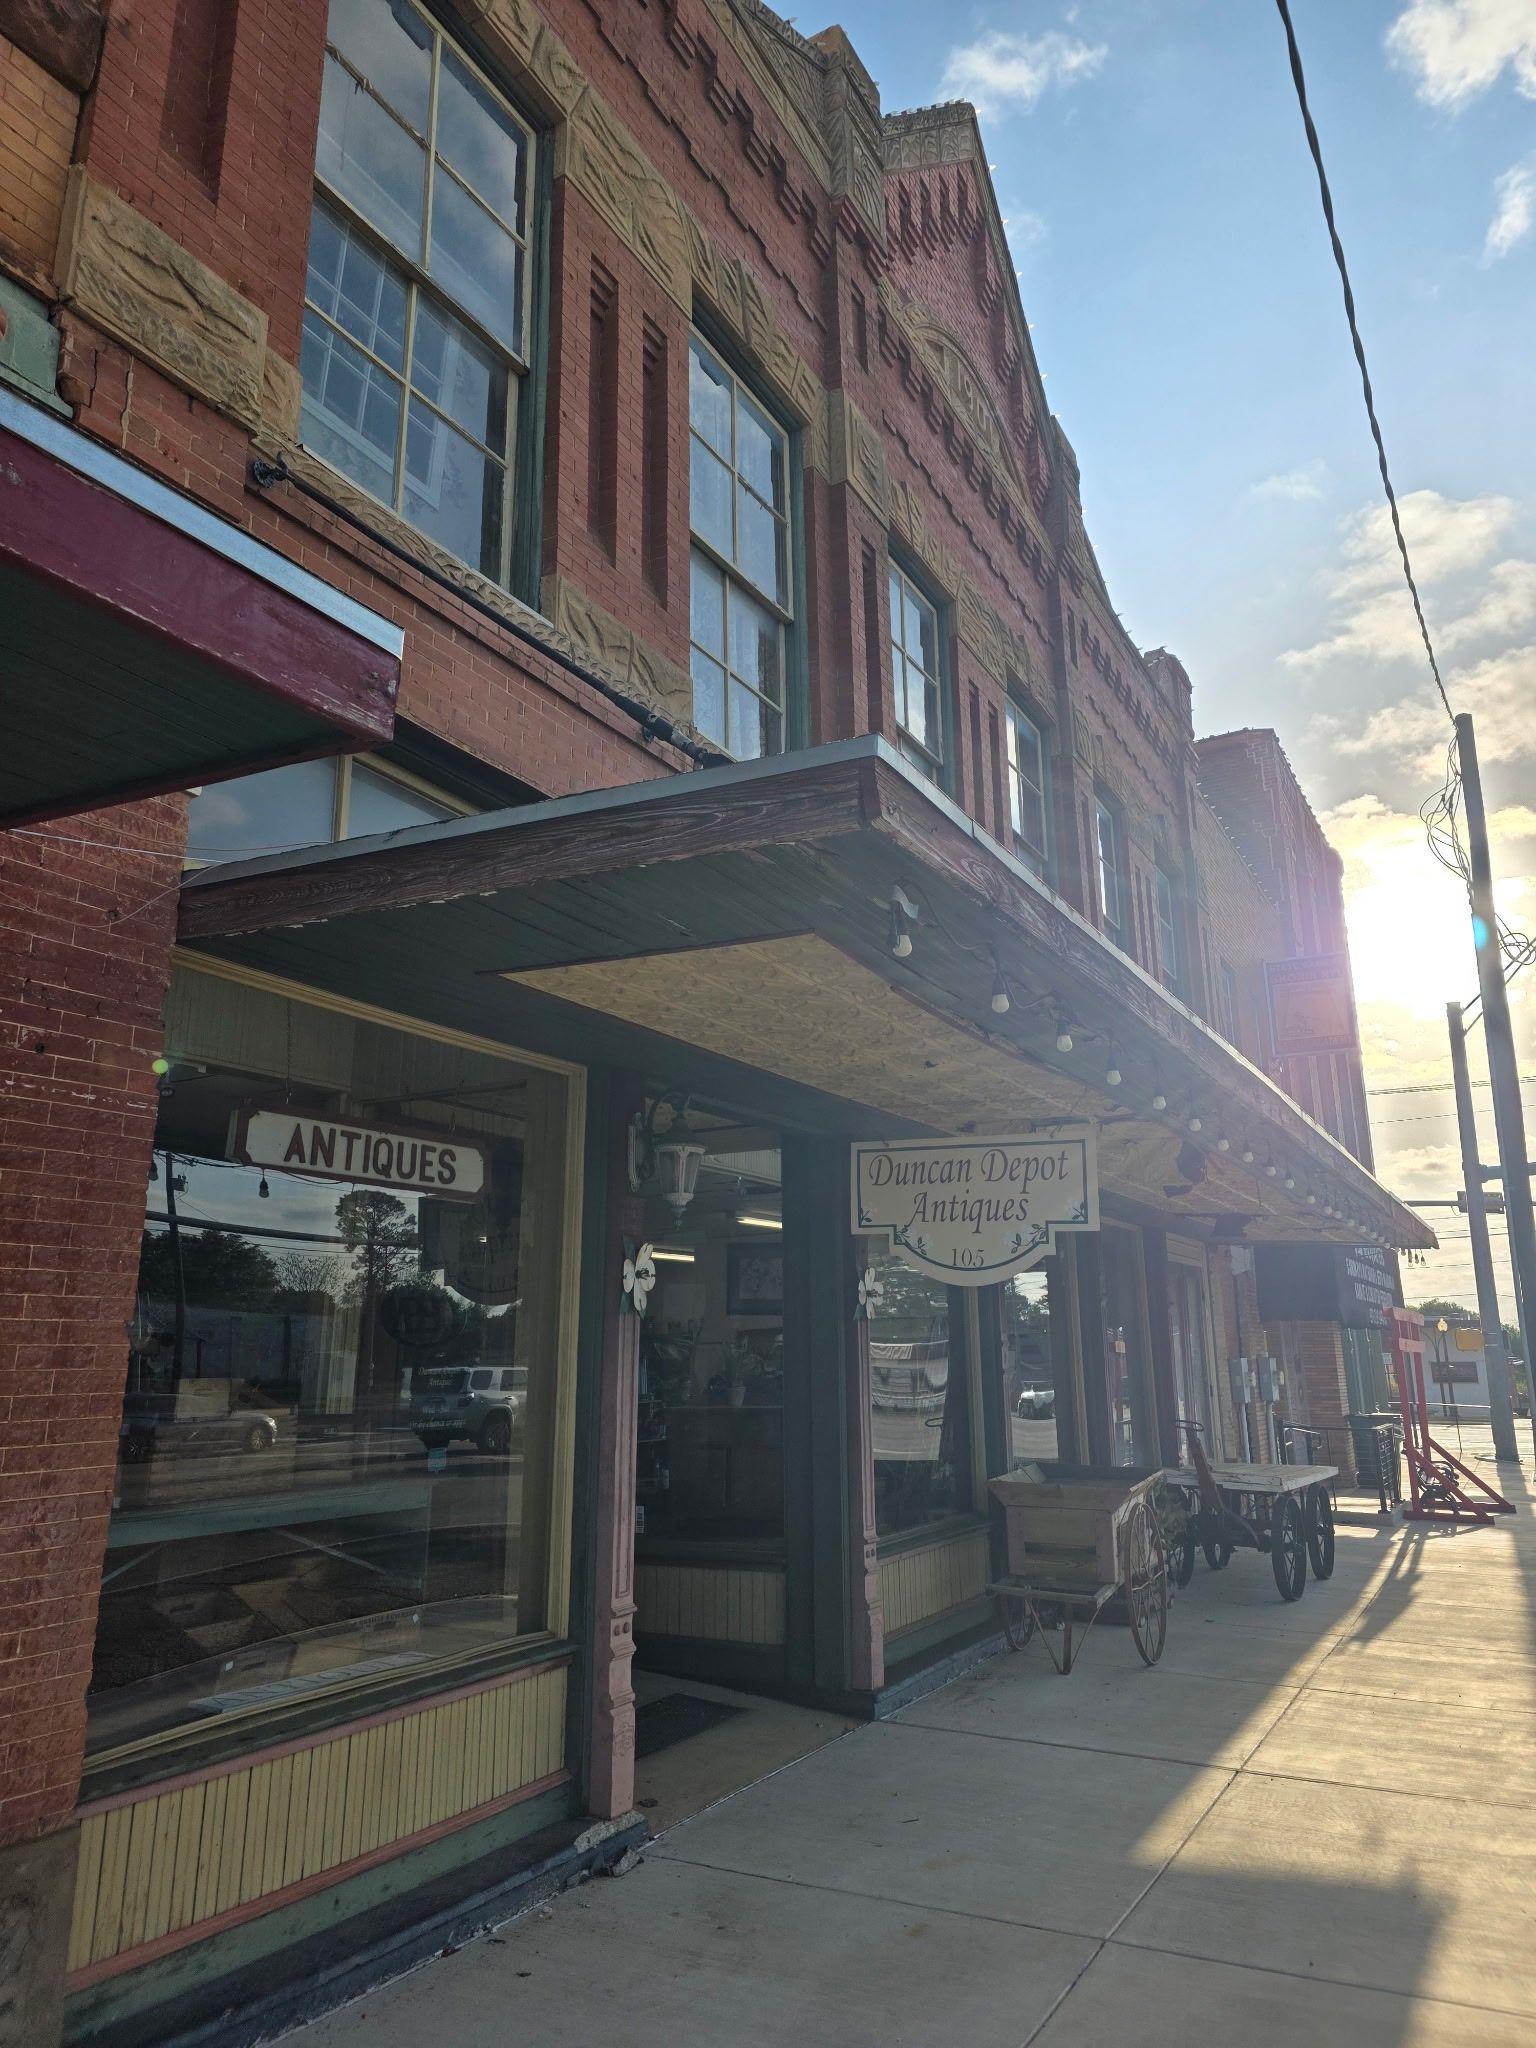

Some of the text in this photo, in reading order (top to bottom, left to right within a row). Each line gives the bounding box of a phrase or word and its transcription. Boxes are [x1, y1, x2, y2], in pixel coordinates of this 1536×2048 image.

[283, 1122, 458, 1186] ANTIQUES
[868, 1148, 1070, 1195] Duncan Depot
[905, 1188, 1030, 1235] Antiques
[951, 1247, 985, 1268] 105
